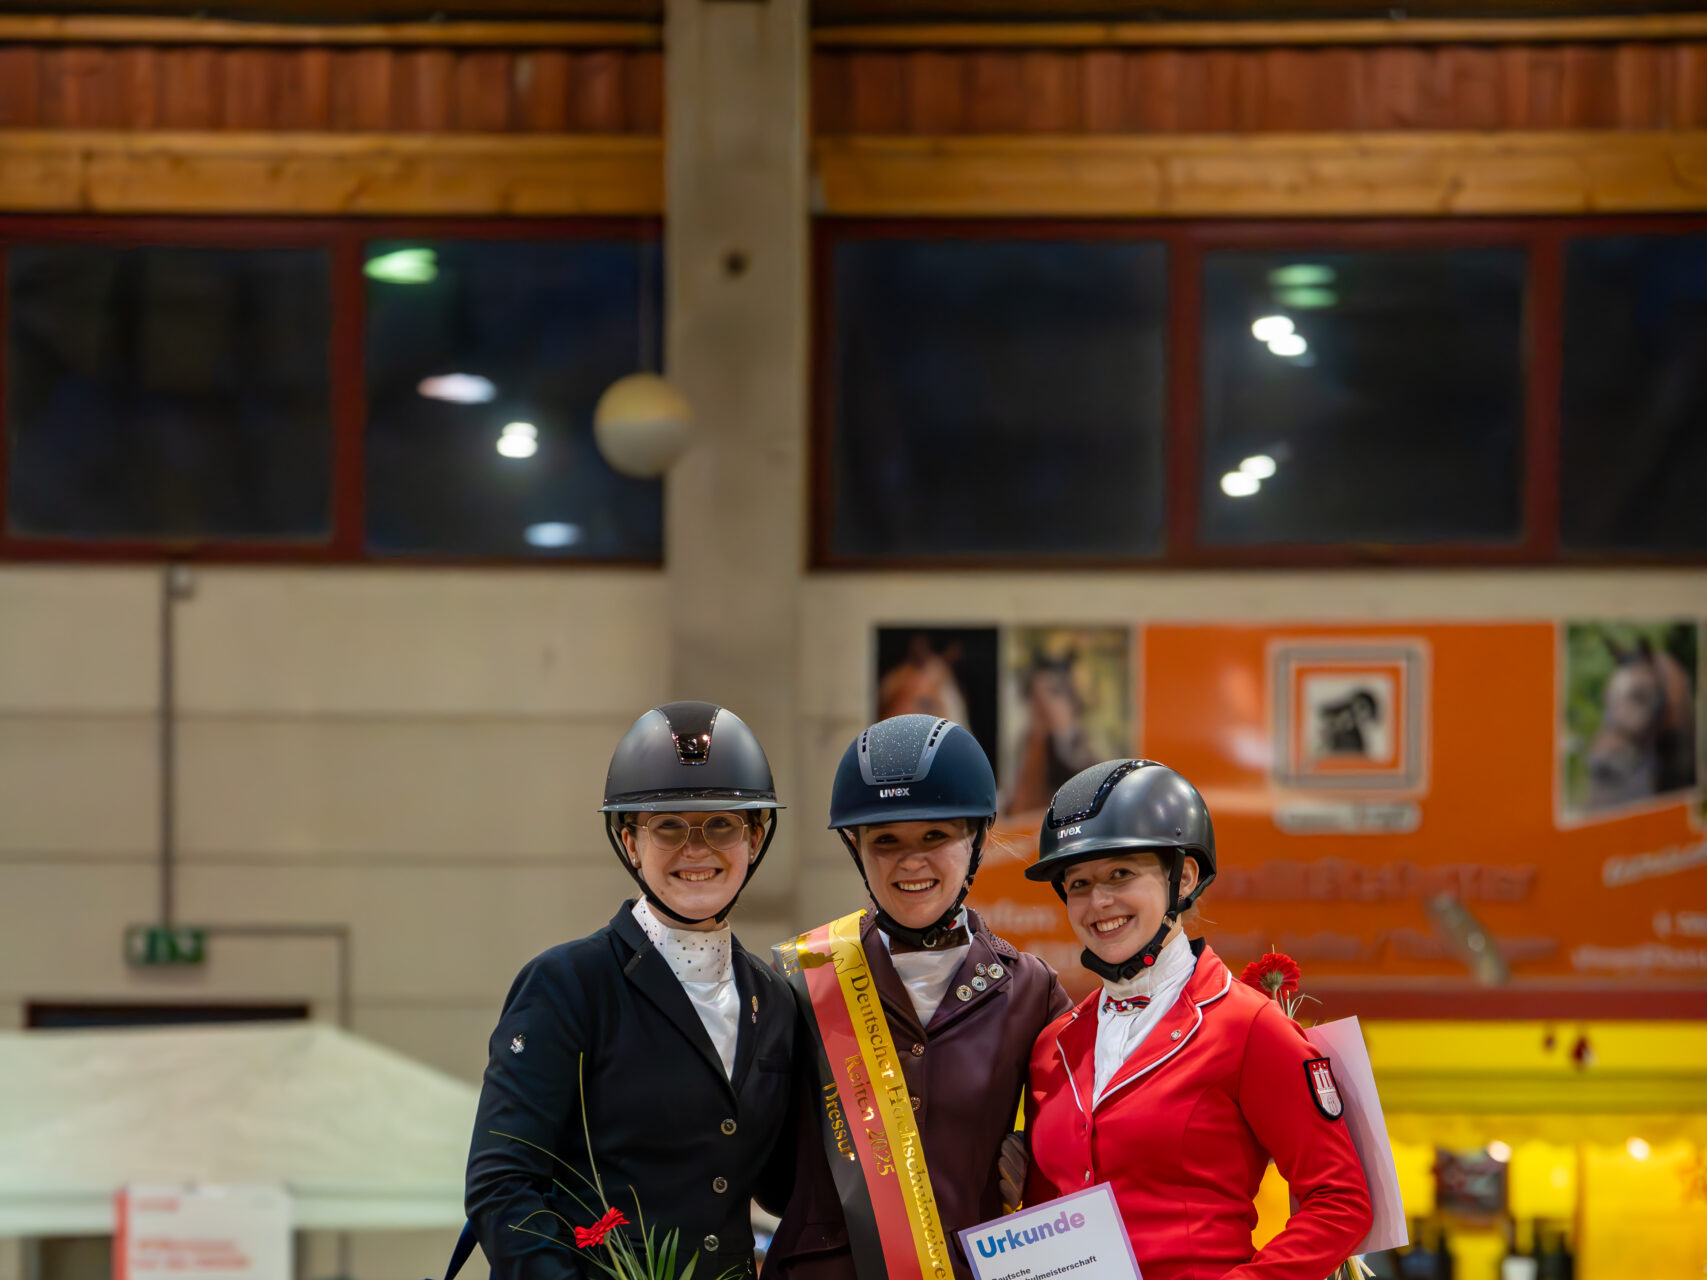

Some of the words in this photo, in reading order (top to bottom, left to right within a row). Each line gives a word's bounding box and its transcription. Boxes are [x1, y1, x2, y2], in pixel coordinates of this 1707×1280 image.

[879, 787, 910, 798] uvex
[1057, 825, 1082, 839] uvex
[850, 970, 895, 1080] Deutscher
[822, 1080, 855, 1162] Dressur
[843, 1054, 875, 1122] Reiten
[866, 1127, 896, 1177] 2025
[976, 1210, 1086, 1259] Urkunde
